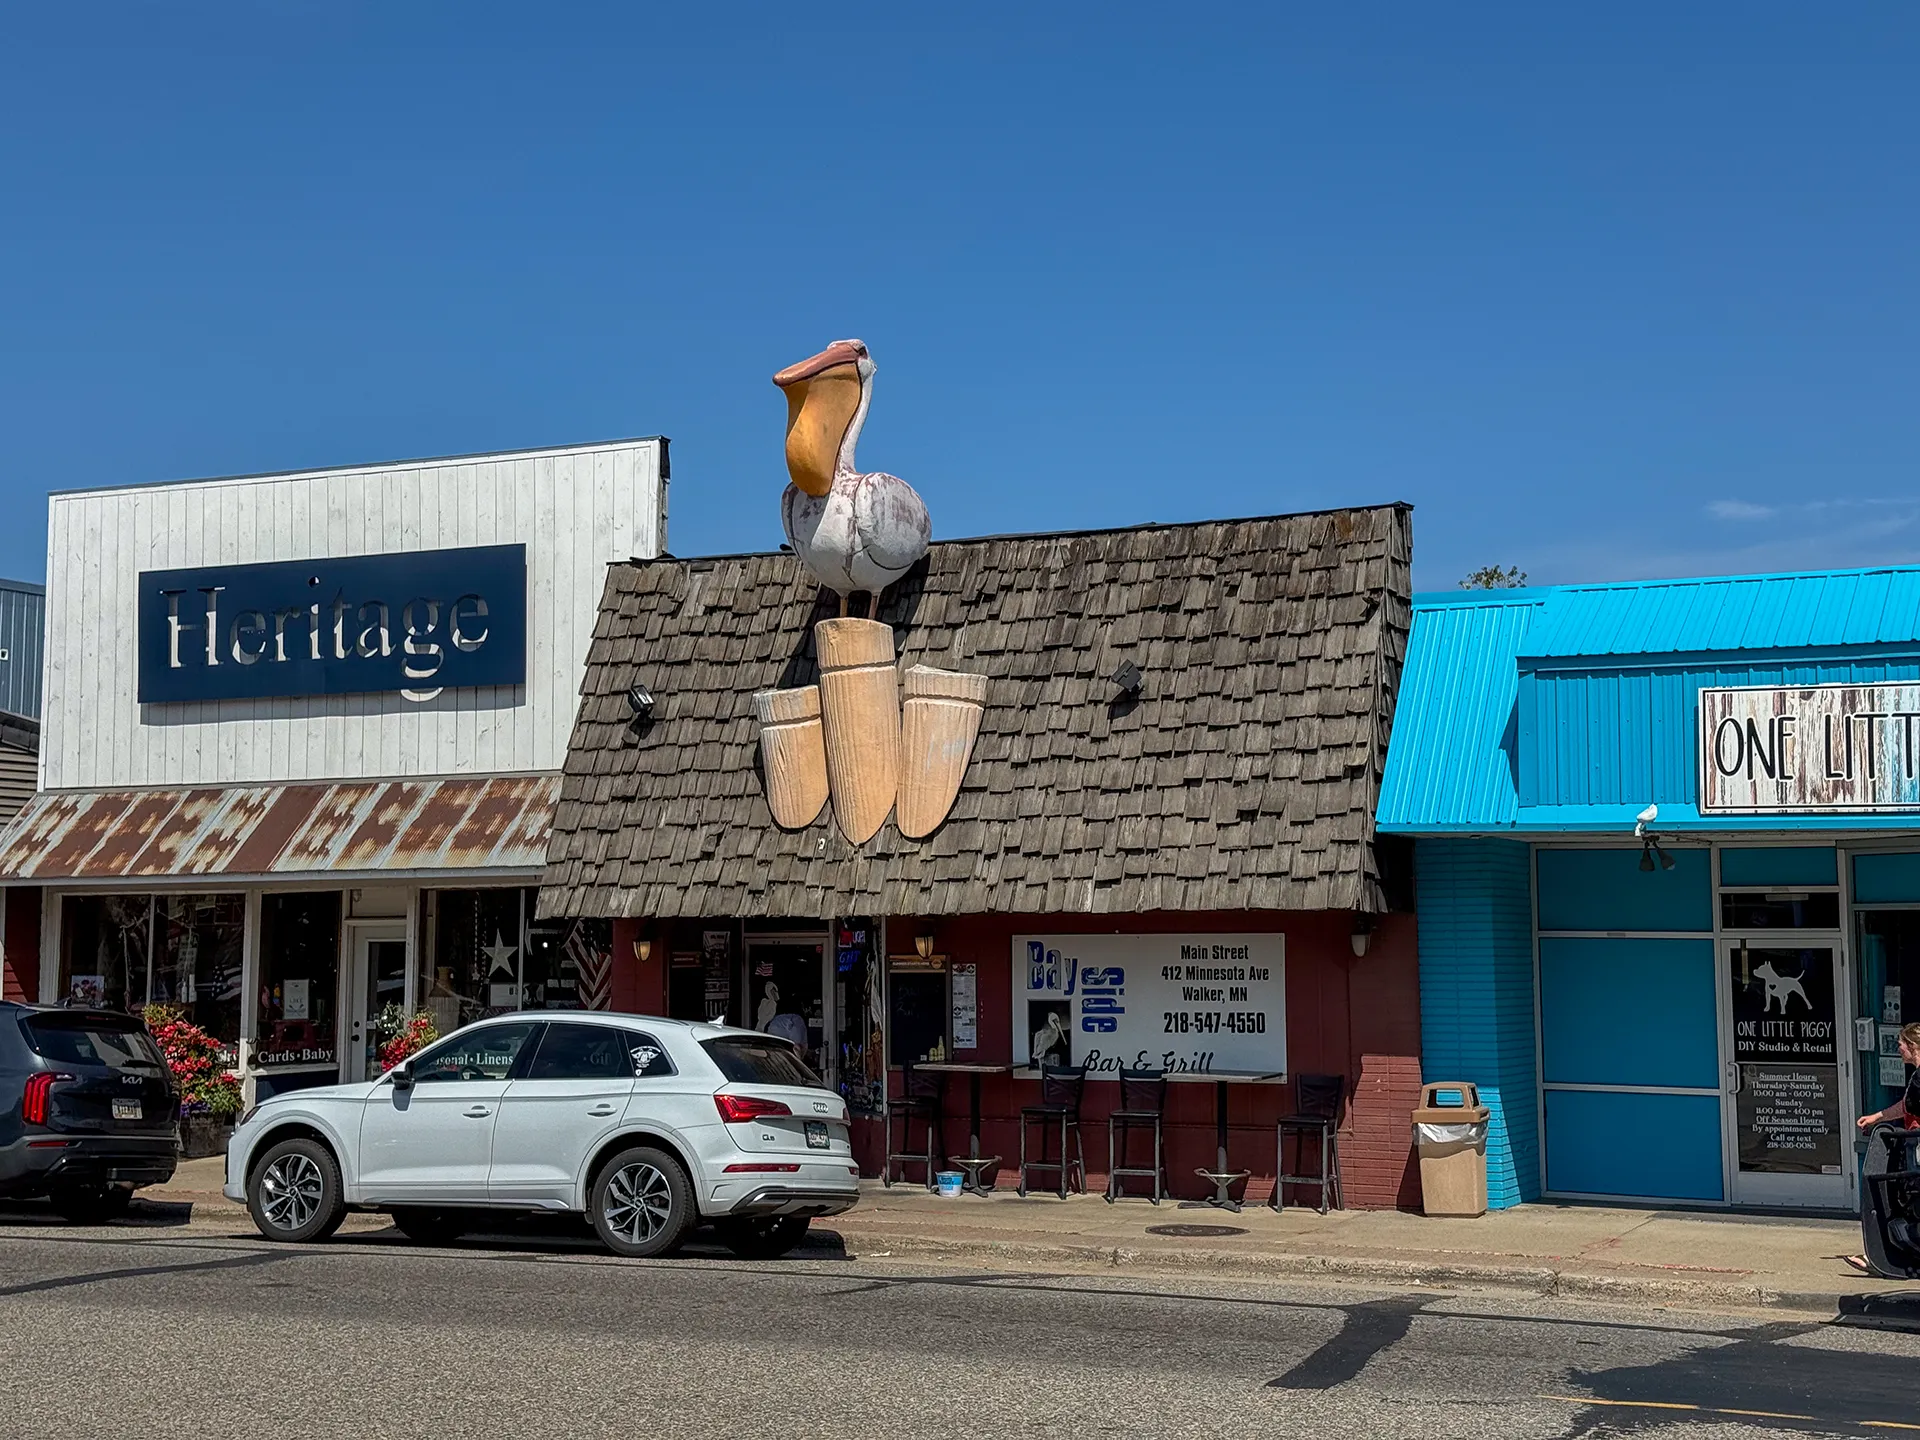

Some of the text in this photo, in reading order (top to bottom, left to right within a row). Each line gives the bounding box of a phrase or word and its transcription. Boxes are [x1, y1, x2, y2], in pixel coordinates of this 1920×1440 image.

[158, 575, 490, 679] Heritage
[1715, 717, 1795, 779] ONE
[1180, 944, 1250, 960] Main Street
[1026, 940, 1078, 995] Bay
[1161, 965, 1269, 981] 412 Minnesota Ave
[1081, 966, 1126, 1033] Side
[1182, 986, 1248, 1003] Walker, MN
[1163, 1011, 1266, 1034] 218-547-4550
[1738, 1021, 1832, 1038] ONE LITTLE PIGGY
[1738, 1041, 1832, 1053] DIY Studio & Retail
[258, 1048, 334, 1063] Cards Baby
[476, 1052, 514, 1065] Linens
[1082, 1049, 1214, 1073] Bar & Grill
[1759, 1072, 1791, 1080] Summer
[1775, 1098, 1803, 1108] Sunday
[1756, 1115, 1770, 1124] Off
[1771, 1115, 1798, 1125] Season
[1812, 1109, 1824, 1117] pm
[1752, 1124, 1829, 1135] By appointment only
[1770, 1133, 1785, 1141] Call
